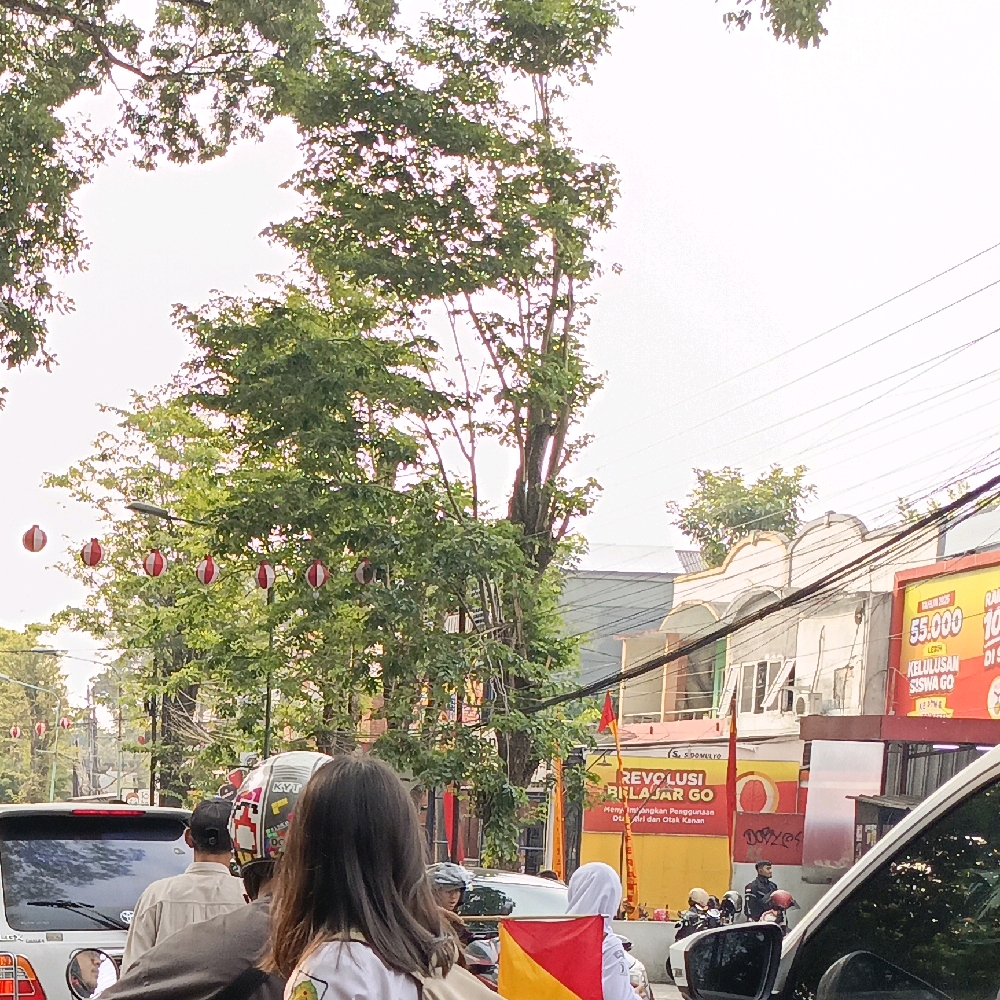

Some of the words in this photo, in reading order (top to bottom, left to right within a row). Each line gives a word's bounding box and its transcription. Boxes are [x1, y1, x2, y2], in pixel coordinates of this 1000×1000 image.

[909, 607, 962, 645] 55.000
[907, 655, 959, 678] KELULUSAN
[909, 676, 940, 694] SISWA
[940, 674, 955, 691] GO
[622, 770, 704, 787] REVOLUSI
[272, 781, 303, 793] KYT
[688, 788, 714, 802] GO
[603, 806, 668, 816] Menyimangkan
[669, 807, 715, 816] Penggunaan
[662, 816, 680, 824] Otak
